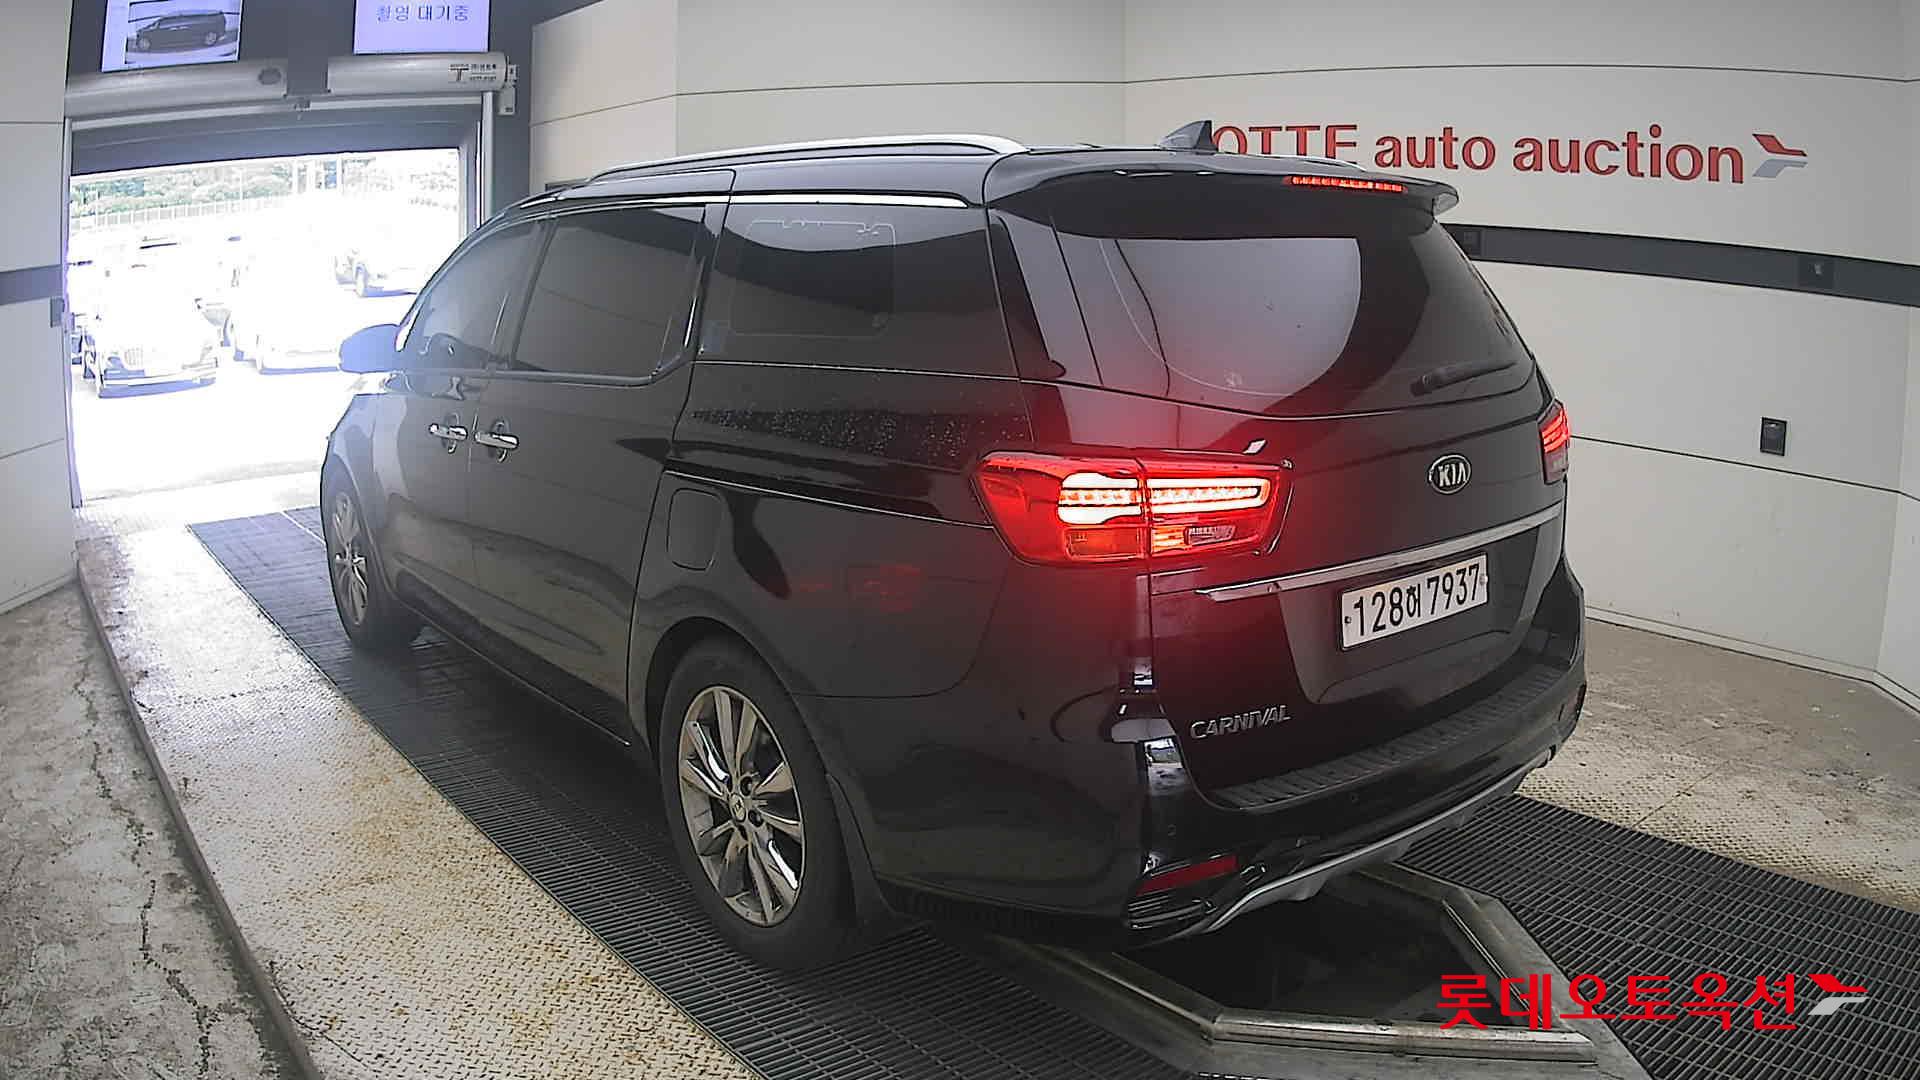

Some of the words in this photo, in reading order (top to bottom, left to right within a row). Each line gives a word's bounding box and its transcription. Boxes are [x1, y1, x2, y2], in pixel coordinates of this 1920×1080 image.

[418, 4, 468, 21] 대기중
[1212, 124, 1358, 165] OTTE
[1374, 127, 1496, 170] auto
[1513, 124, 1744, 184] auction
[1190, 705, 1291, 739] CARNIVAL
